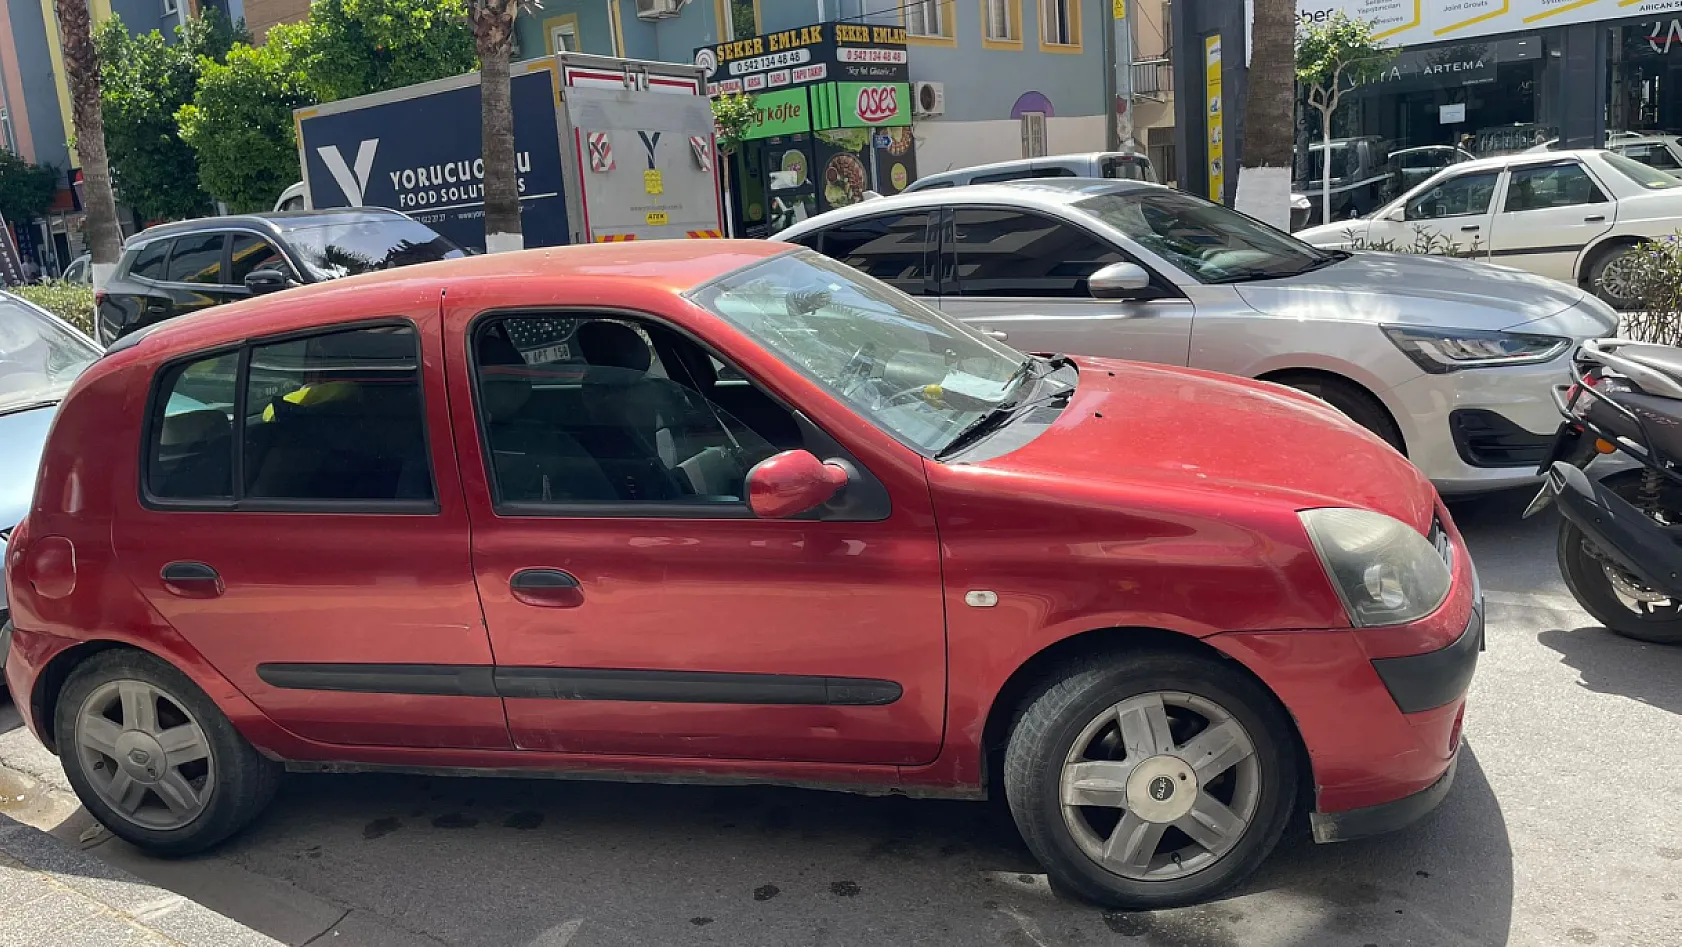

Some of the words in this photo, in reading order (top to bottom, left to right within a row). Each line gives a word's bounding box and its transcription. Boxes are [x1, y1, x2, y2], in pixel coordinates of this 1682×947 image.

[716, 38, 764, 66] ŞEKER
[768, 25, 823, 52] EMLAK
[836, 24, 870, 47] ŞEKER
[737, 63, 743, 73] 0
[744, 60, 759, 71] 542
[760, 56, 776, 68] 134
[777, 54, 788, 65] 48
[789, 51, 801, 62] 48
[1423, 60, 1485, 75] ARTEMA
[767, 101, 801, 124] köfte
[389, 150, 532, 191] YORUCUOU
[400, 190, 438, 208] FOOD
[441, 177, 526, 203] SOLUTS
